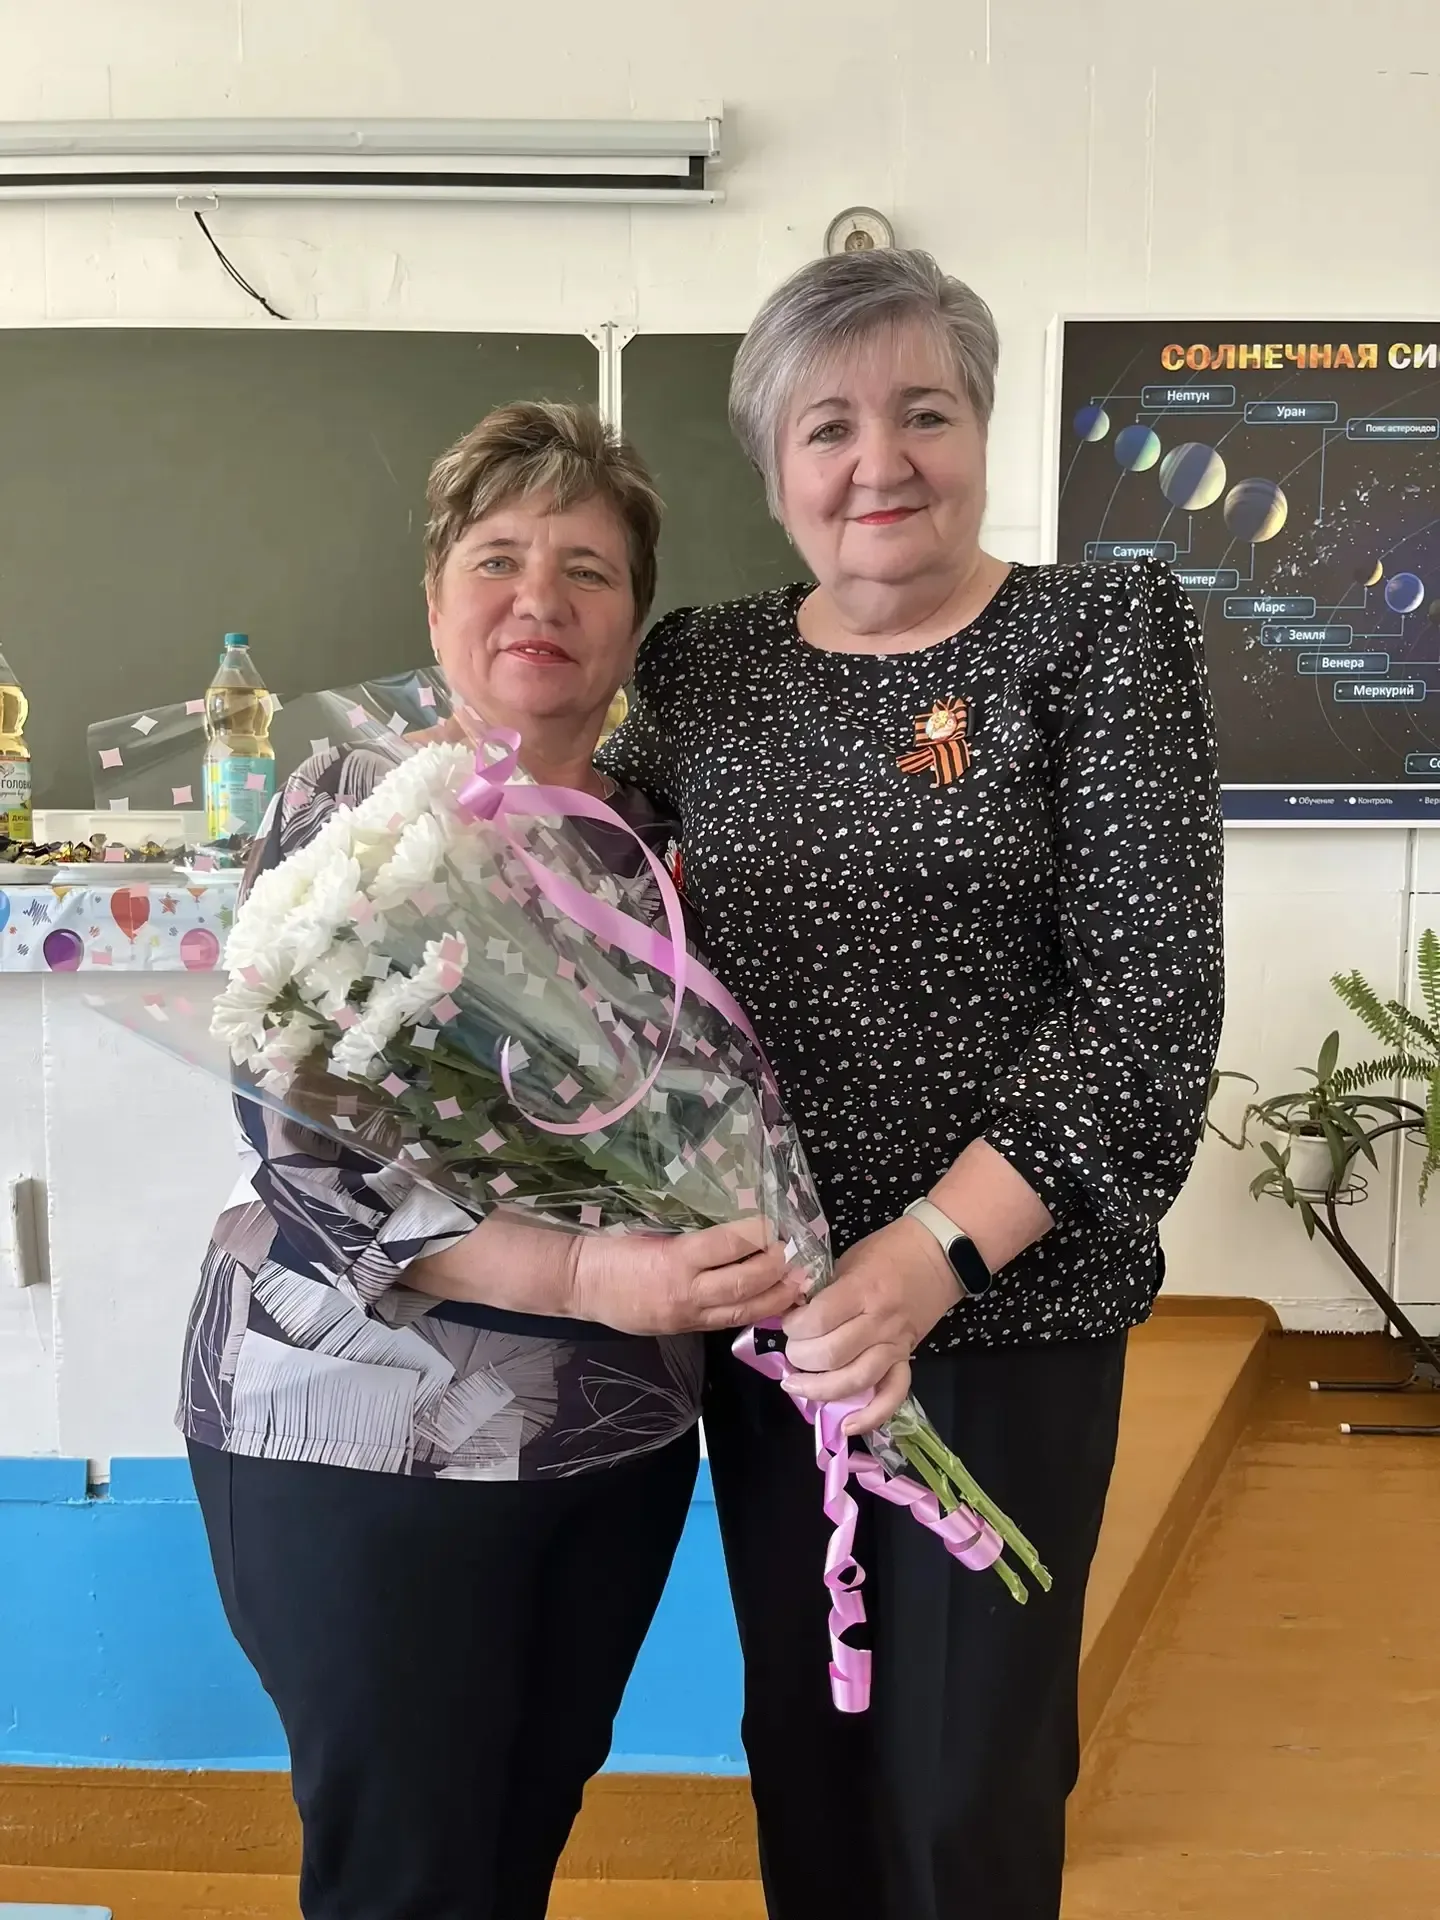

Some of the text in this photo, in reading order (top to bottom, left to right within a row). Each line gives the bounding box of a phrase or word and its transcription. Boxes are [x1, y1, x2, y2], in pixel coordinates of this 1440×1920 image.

[1160, 342, 1440, 370] СОЛНЕЧНАЯ СИ
[1166, 389, 1210, 403] Нептун
[1276, 406, 1306, 419] Уран
[1365, 424, 1436, 434] Пояс астероидов
[1253, 601, 1286, 614] Марс
[1288, 629, 1326, 641] Земля
[1321, 657, 1365, 669] Венера
[1353, 683, 1415, 698] Меркурий
[1298, 796, 1335, 806] Обучение
[1357, 796, 1394, 806] Контроль
